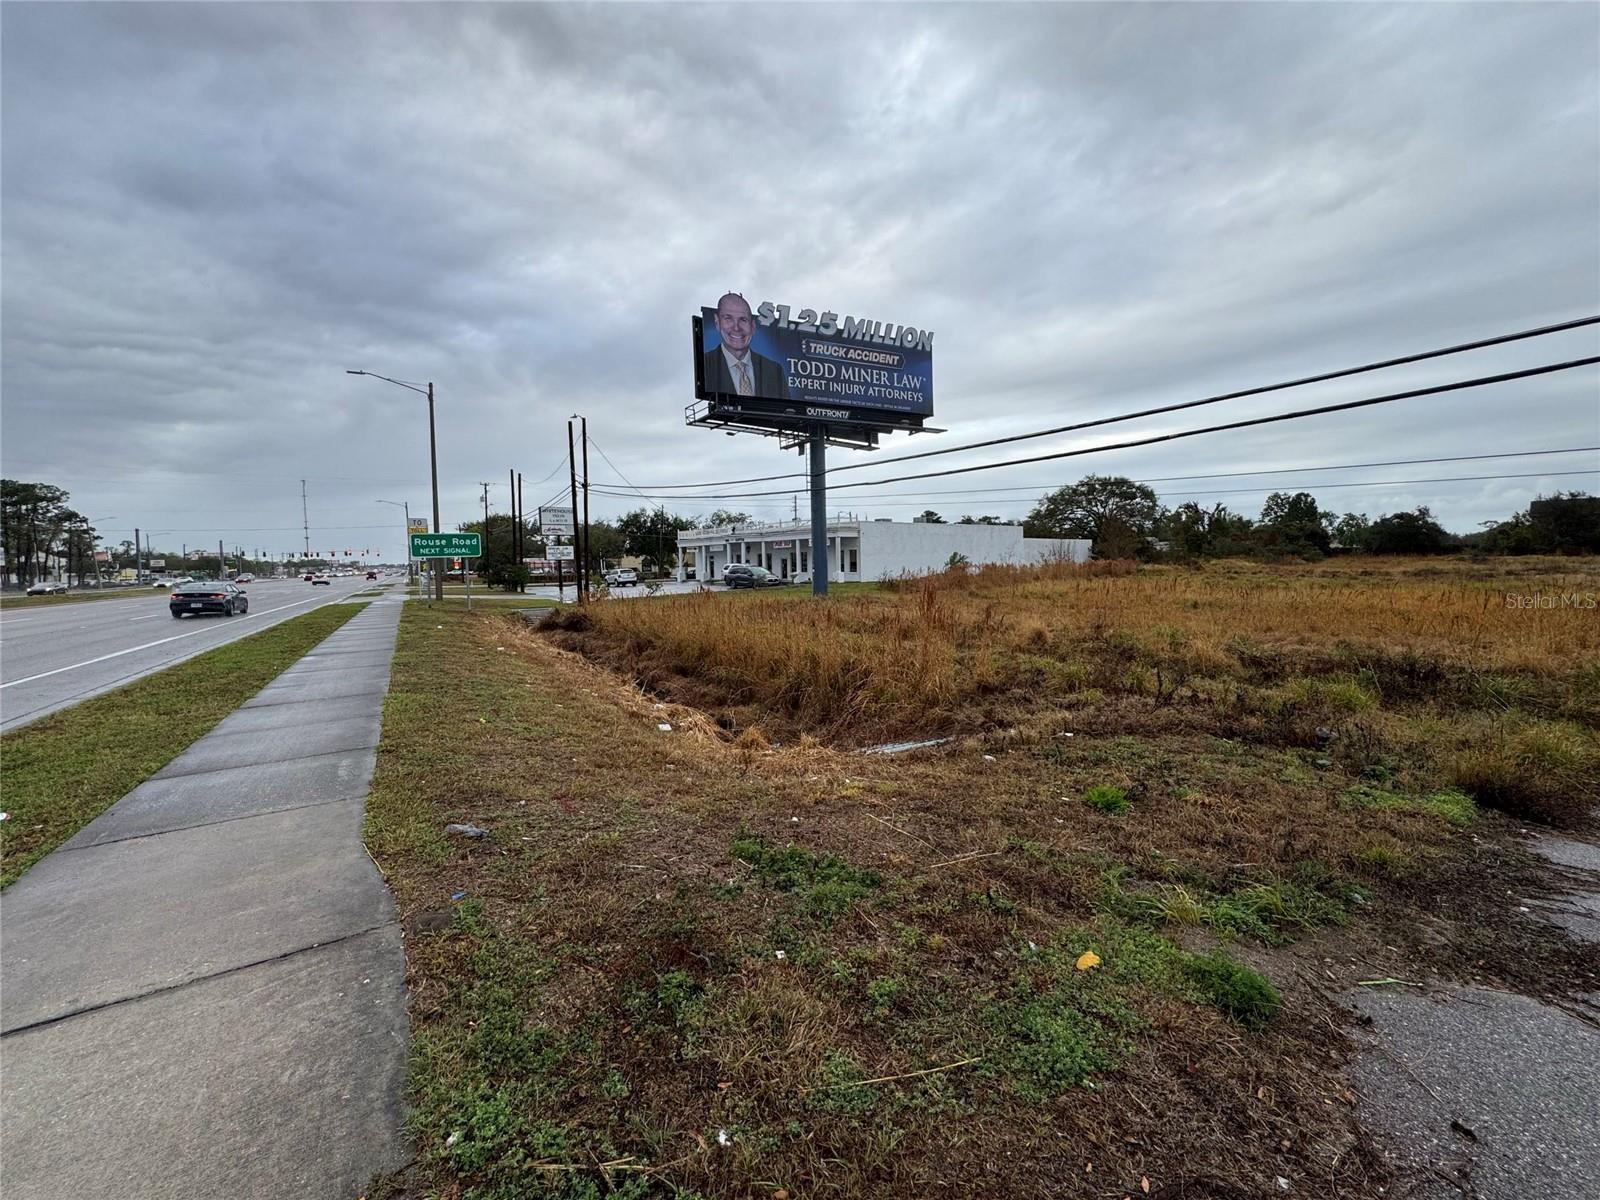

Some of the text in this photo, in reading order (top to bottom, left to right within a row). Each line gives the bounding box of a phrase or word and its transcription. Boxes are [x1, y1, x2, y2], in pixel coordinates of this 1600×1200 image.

[757, 301, 934, 351] $1.25 MILLION
[810, 343, 900, 366] TRUCK ACCIDENT
[787, 358, 922, 390] TODD MINER LAW
[788, 377, 827, 391] EXPERT
[830, 382, 866, 397] INJURY
[868, 387, 923, 403] ATTORNEYS
[414, 537, 477, 546] Rouse Road
